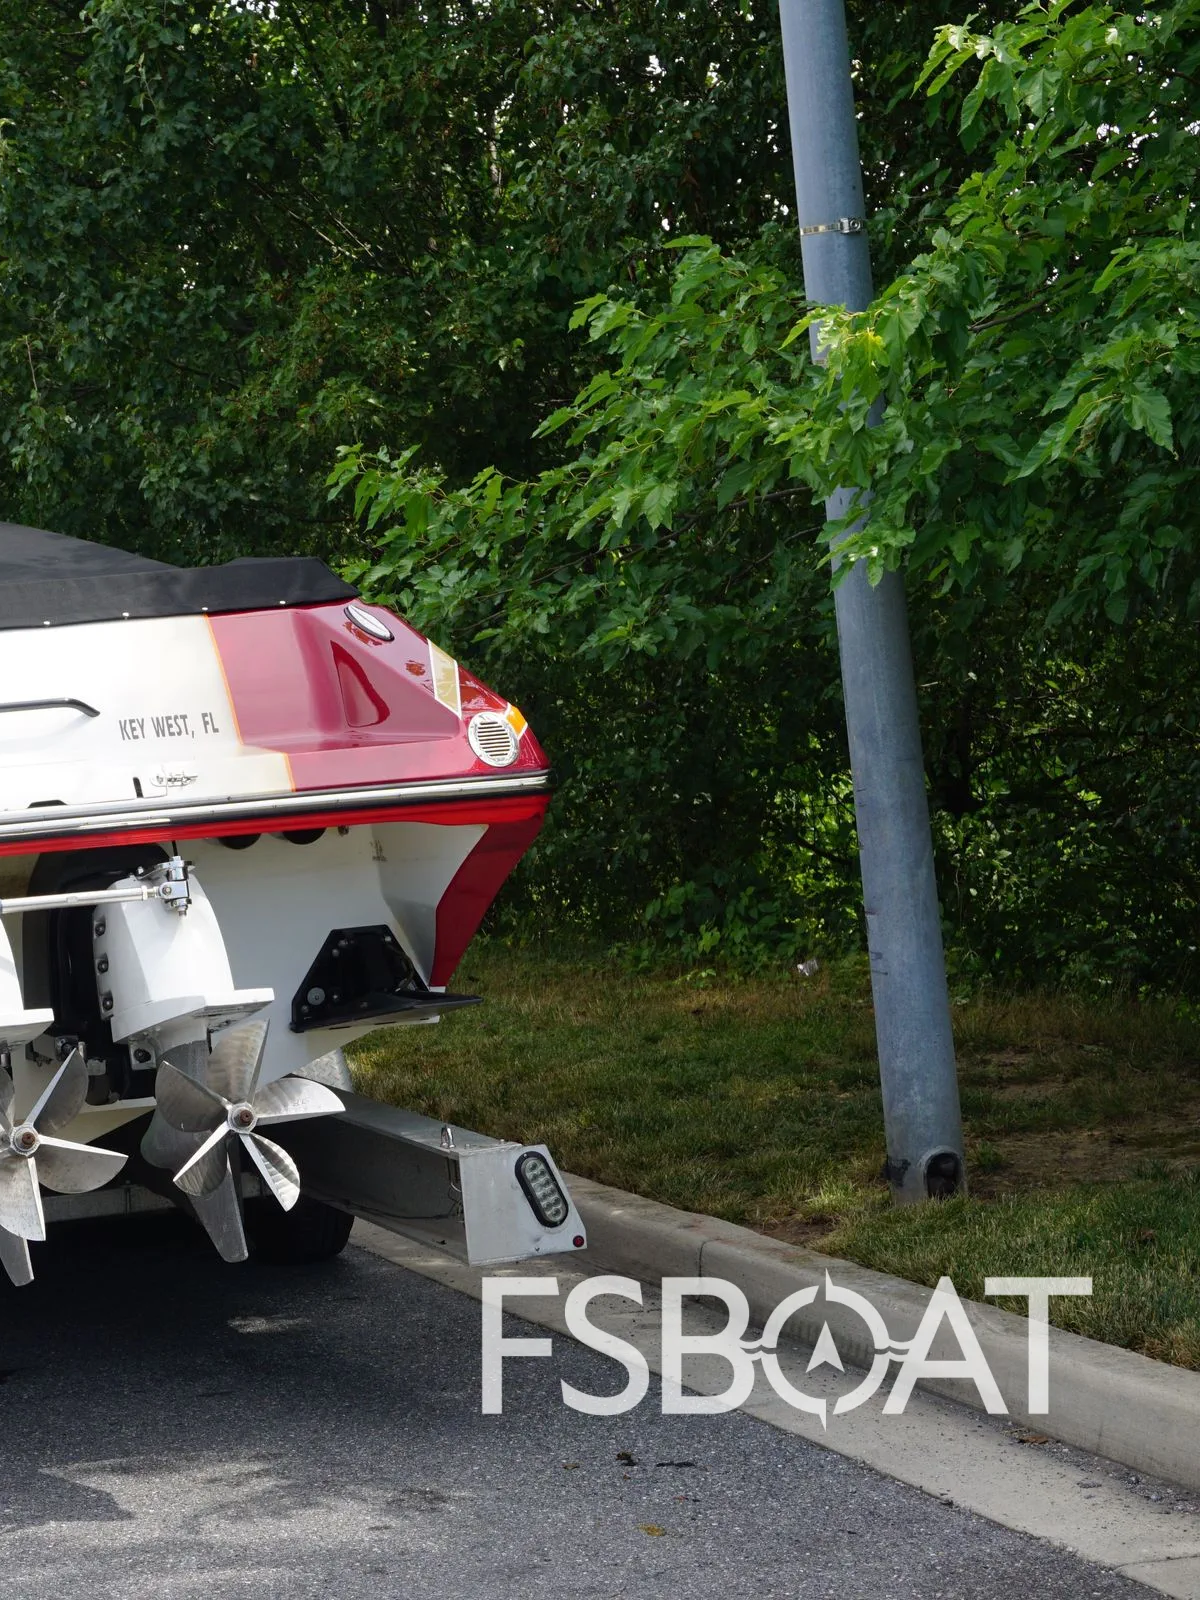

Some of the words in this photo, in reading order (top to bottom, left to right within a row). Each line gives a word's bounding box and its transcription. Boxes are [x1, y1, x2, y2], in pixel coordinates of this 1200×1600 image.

[119, 717, 145, 741] KEY
[151, 714, 195, 739] WEST,
[201, 712, 220, 734] FL
